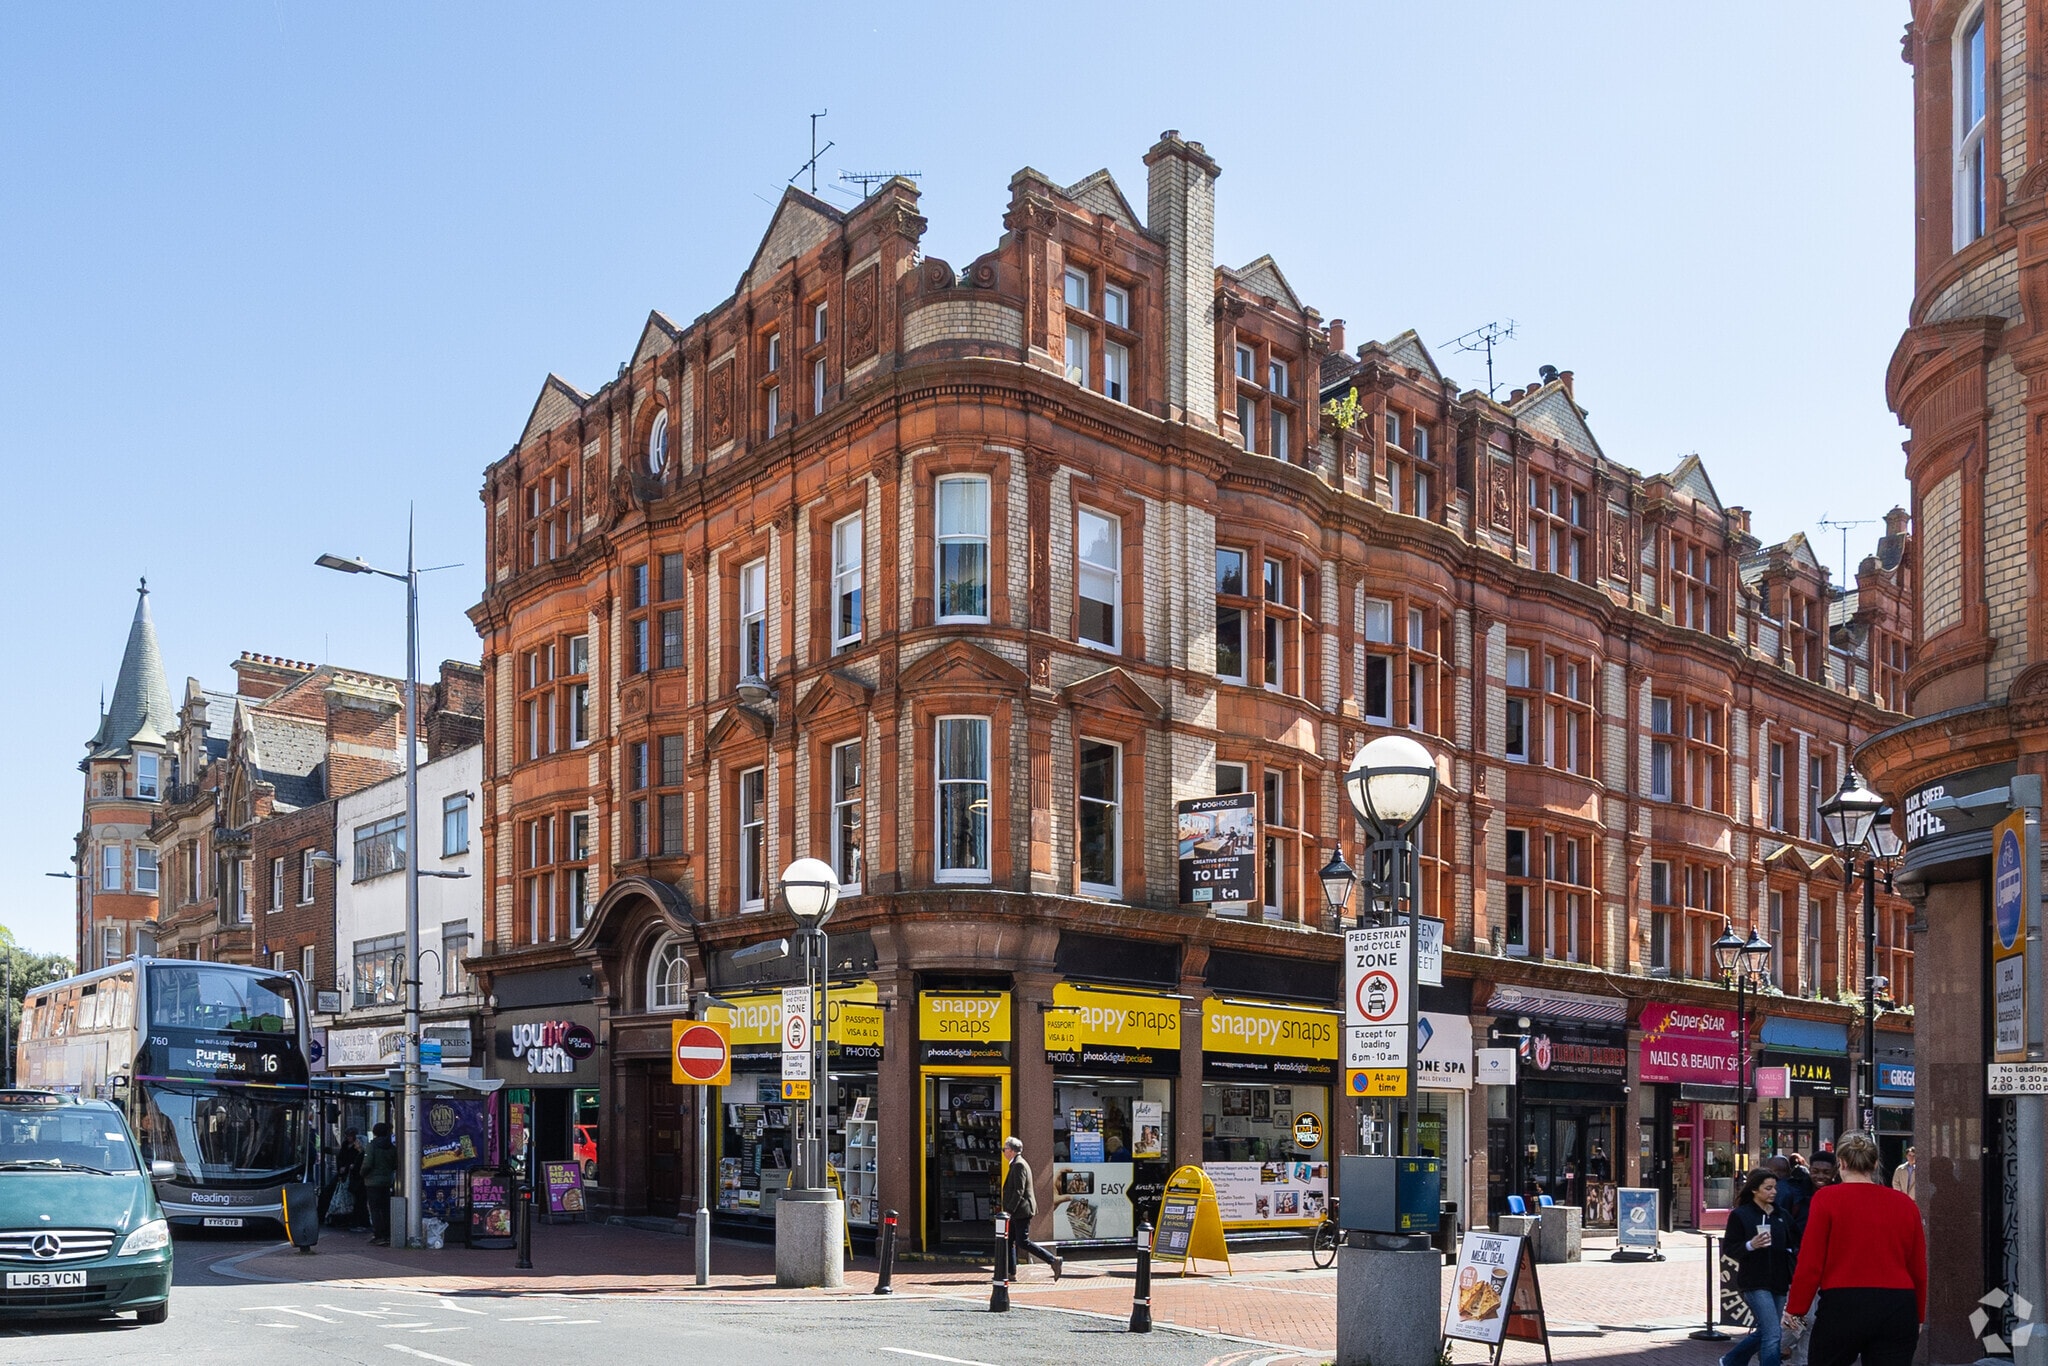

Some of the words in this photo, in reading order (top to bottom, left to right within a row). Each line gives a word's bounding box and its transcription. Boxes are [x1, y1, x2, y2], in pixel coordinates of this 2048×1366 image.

[1922, 786, 1944, 806] SHEEP
[1202, 800, 1238, 808] DOGHOUSE
[1907, 808, 1945, 843] COFFEE
[1193, 870, 1210, 881] TO
[1215, 868, 1239, 879] LET
[1349, 930, 1407, 942] PEDESTRIAN
[1418, 923, 1434, 937] EEN
[1354, 943, 1368, 951] and
[1372, 941, 1401, 950] CYCLE
[1418, 940, 1439, 955] ORIA
[1357, 953, 1397, 968] ZONE
[1419, 956, 1434, 970] EET
[788, 1004, 805, 1013] ZONE
[932, 1000, 1001, 1018] snappy
[729, 1004, 782, 1036] snapp
[846, 1015, 879, 1024] PASSPORT
[1048, 1021, 1075, 1029] PASSPORT
[846, 1028, 861, 1036] VISA
[940, 1020, 990, 1038] snaps
[1355, 1030, 1383, 1040] Except
[1384, 1028, 1396, 1038] for
[151, 1037, 168, 1046] 760
[1360, 1036, 1390, 1049] loading
[196, 1049, 236, 1062] Purley
[527, 1044, 573, 1073] sushi
[846, 1047, 880, 1058] PHOTOS
[1048, 1052, 1075, 1062] PHOTOS
[1352, 1053, 1357, 1061] 6
[1358, 1055, 1370, 1063] pm
[1552, 1043, 1590, 1064] TURKISH
[1592, 1046, 1626, 1066] BARBER
[196, 1060, 228, 1070] Overdown
[230, 1062, 245, 1071] Road
[261, 1054, 277, 1072] 16
[1650, 1050, 1678, 1066] NAILS
[1681, 1053, 1688, 1067] &
[1691, 1054, 1724, 1070] BEAUTY
[1727, 1057, 1739, 1071] SP
[1417, 1061, 1439, 1072] ONE
[1444, 1062, 1466, 1073] SPA
[2016, 1065, 2048, 1074] loading
[1374, 1073, 1383, 1081] At
[1386, 1074, 1401, 1083] any
[1890, 1070, 1915, 1086] GREG
[1378, 1083, 1396, 1092] time
[5, 1095, 46, 1104] TAXI
[432, 1108, 451, 1120] WIN
[1135, 1104, 1151, 1117] photo
[1297, 1133, 1320, 1142] PRINT
[1101, 1184, 1125, 1194] EASY
[1101, 1198, 1125, 1206] PRINTS
[1480, 1240, 1502, 1251] LUNCH
[1471, 1250, 1487, 1262] MEAL
[1490, 1251, 1505, 1264] DEAL
[13, 1274, 50, 1286] LJ63
[55, 1273, 81, 1284] VCN
[1721, 1288, 1755, 1327] HEEP
